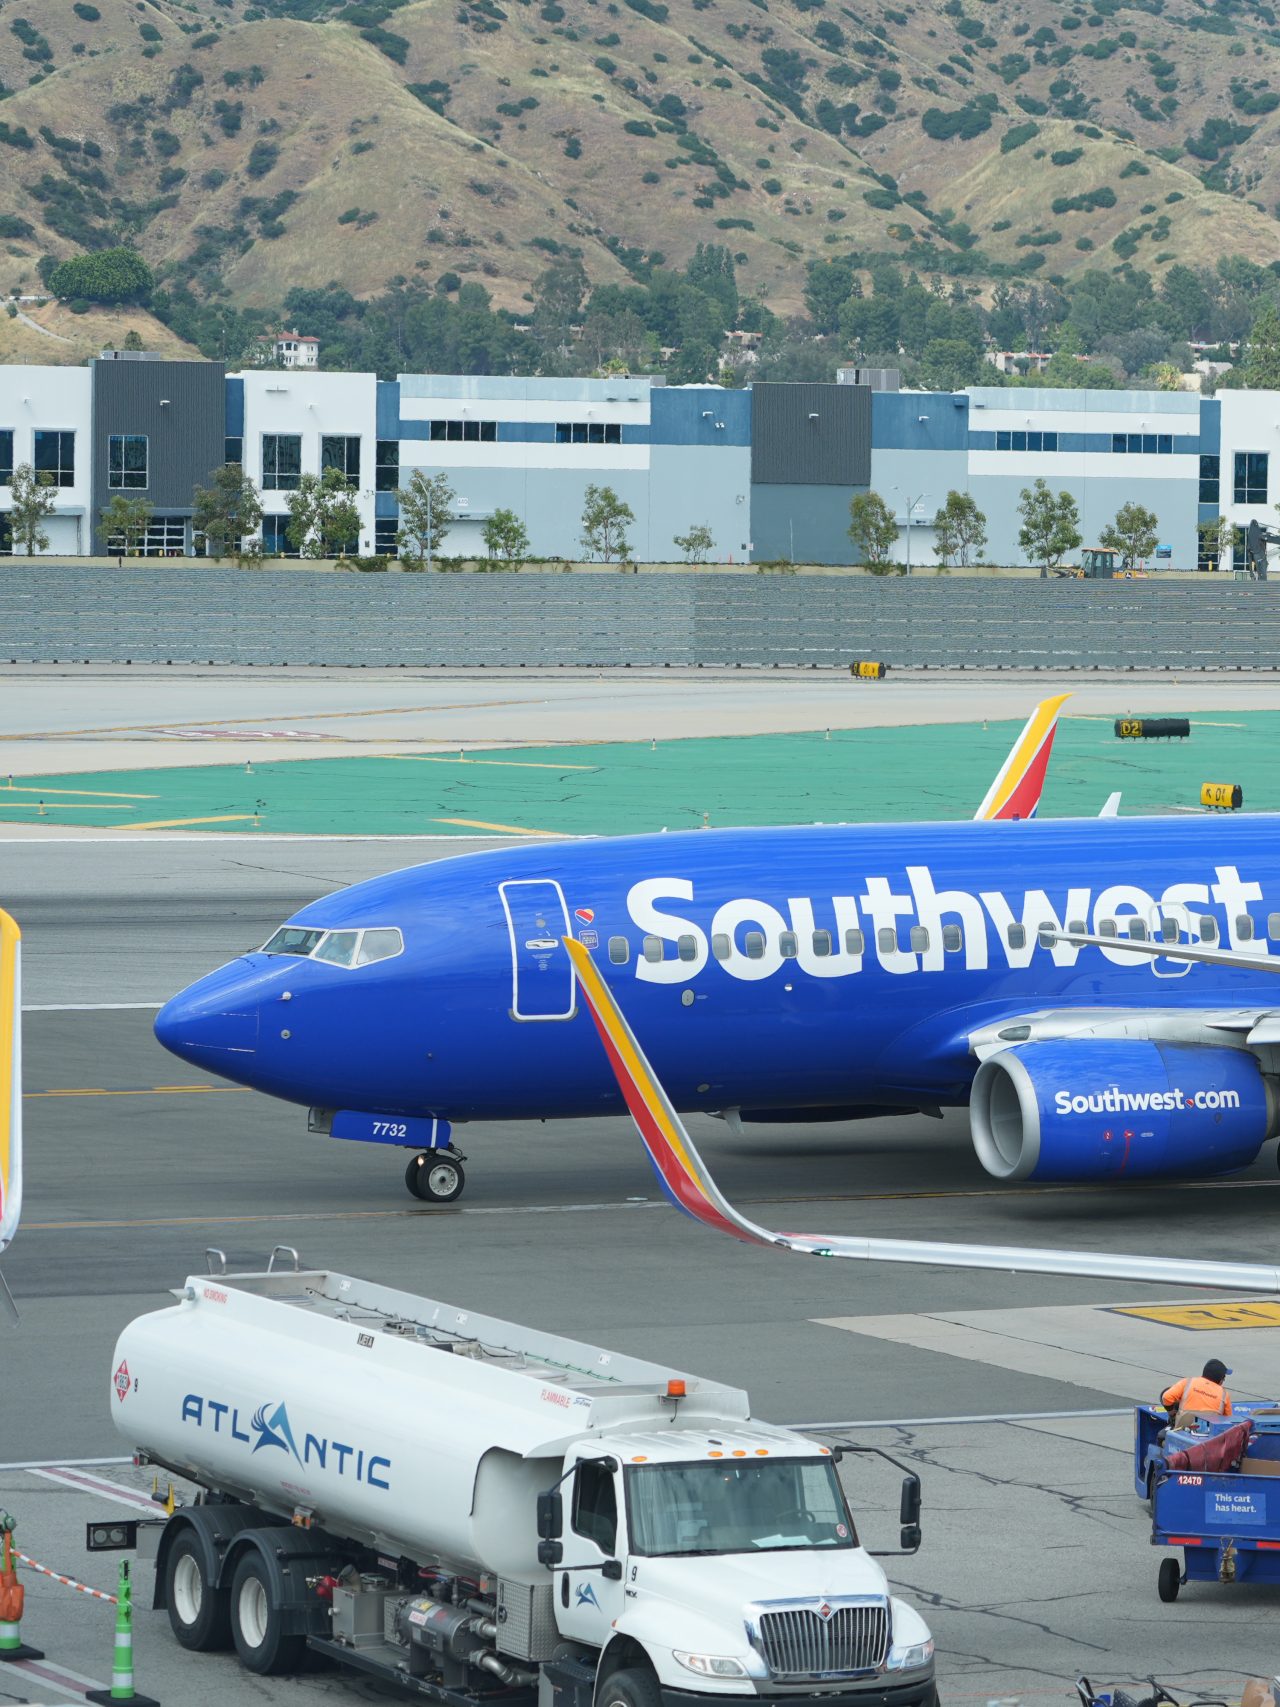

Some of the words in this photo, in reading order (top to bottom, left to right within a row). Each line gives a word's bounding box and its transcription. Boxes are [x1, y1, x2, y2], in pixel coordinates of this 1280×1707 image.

[1122, 722, 1139, 735] D2
[626, 865, 1269, 984] Southwest
[372, 1122, 407, 1137] 7732
[182, 1394, 391, 1490] ATLANTIC
[1178, 1476, 1202, 1485] 12470
[1215, 1493, 1232, 1502] This
[1234, 1494, 1250, 1503] cart
[1215, 1503, 1230, 1512] has
[1231, 1503, 1257, 1513] heart.
[631, 1566, 638, 1581] 9
